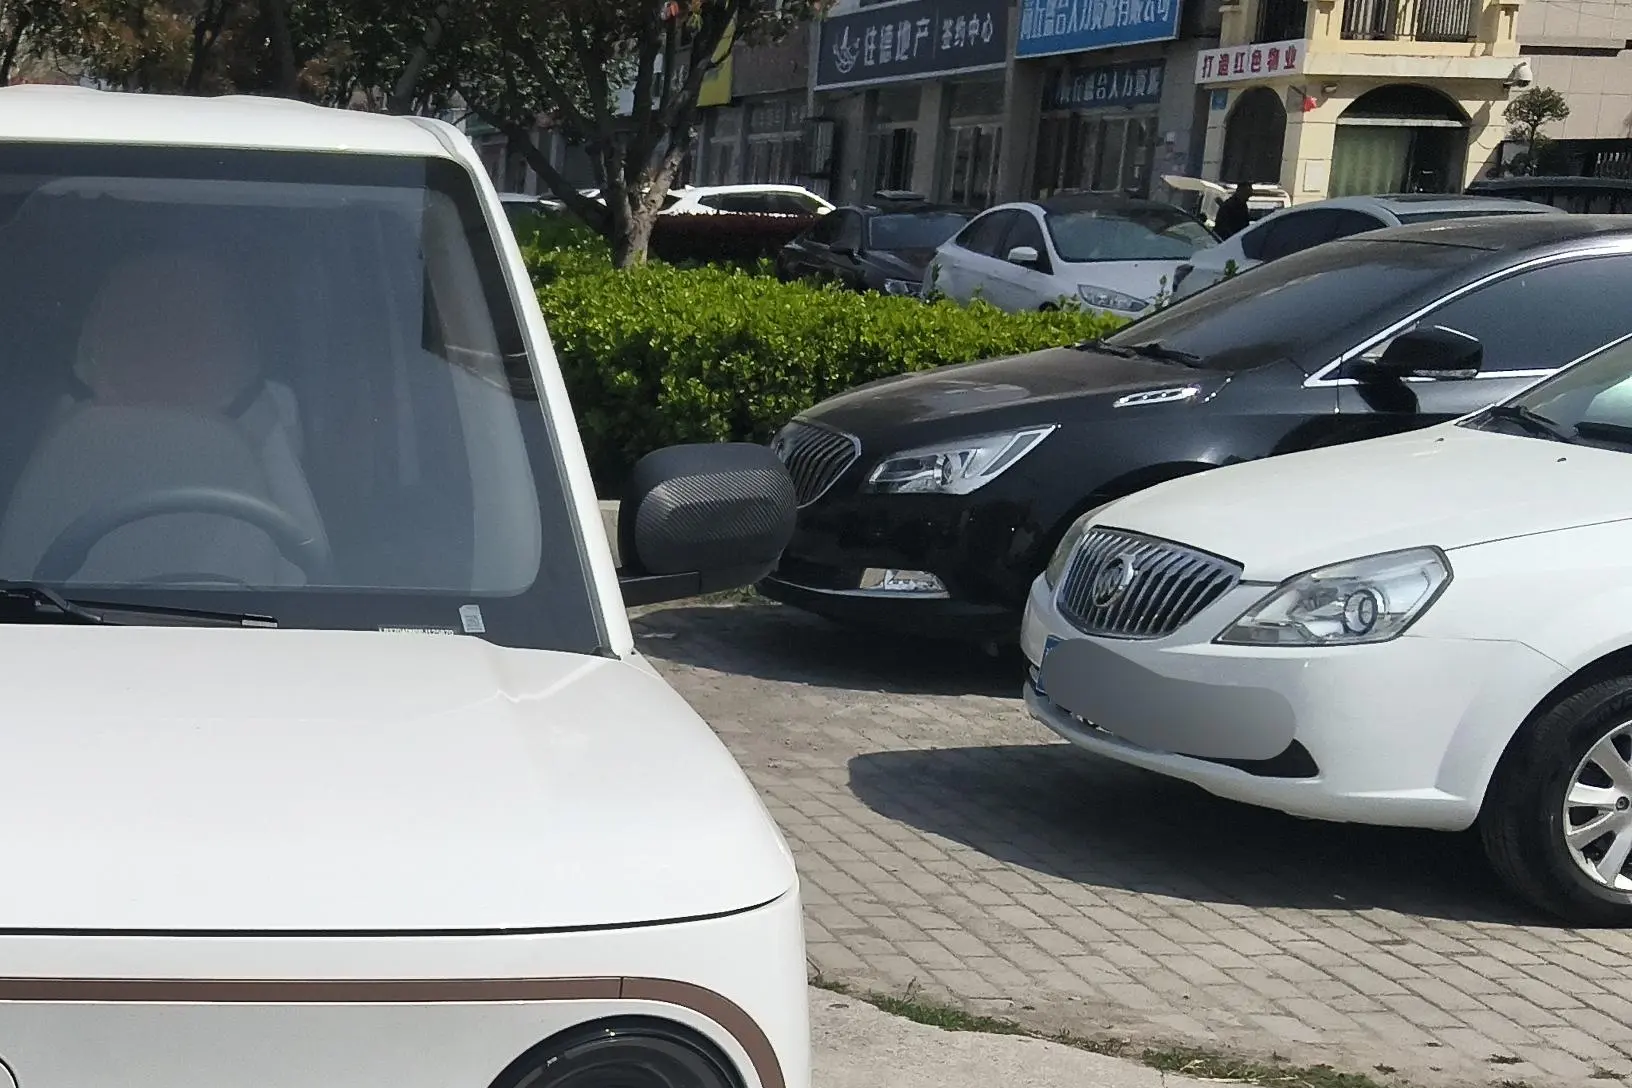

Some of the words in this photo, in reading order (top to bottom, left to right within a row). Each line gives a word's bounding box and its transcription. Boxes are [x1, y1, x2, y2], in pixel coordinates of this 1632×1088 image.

[1201, 44, 1297, 78] 打造红色物业
